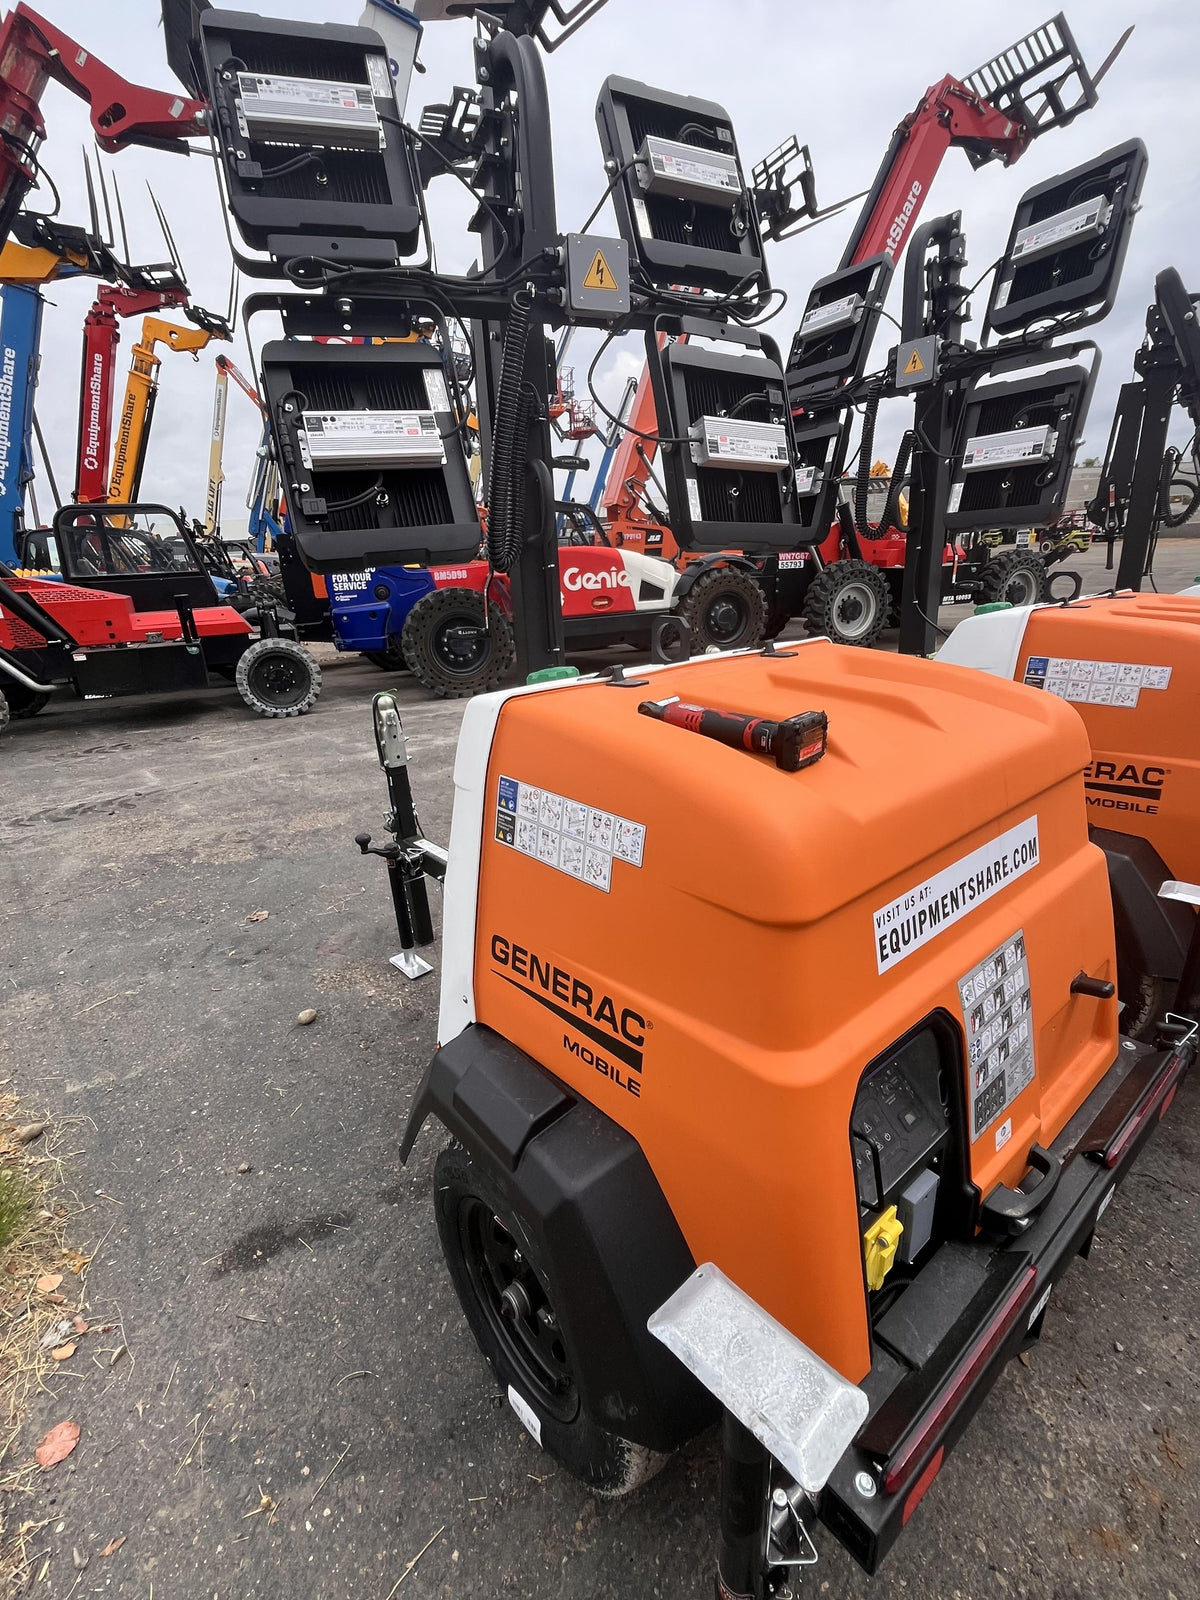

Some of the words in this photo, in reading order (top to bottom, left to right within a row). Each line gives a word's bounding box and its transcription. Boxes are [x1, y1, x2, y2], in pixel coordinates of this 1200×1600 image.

[86, 353, 103, 457] EquipmentShare
[113, 393, 136, 486] EquipmentShare
[647, 534, 661, 542] JLG
[779, 552, 810, 560] WN7G67
[780, 560, 803, 568] 55793
[332, 574, 348, 583] FOR
[350, 572, 372, 582] YOUR
[333, 580, 368, 592] SERVICE
[563, 566, 632, 592] Genie
[875, 904, 901, 929] VISIT
[904, 895, 916, 911] US
[919, 886, 933, 902] AT:
[878, 836, 1038, 963] EQUIPMENTSHARE.COM
[563, 1034, 641, 1098] MOBILE
